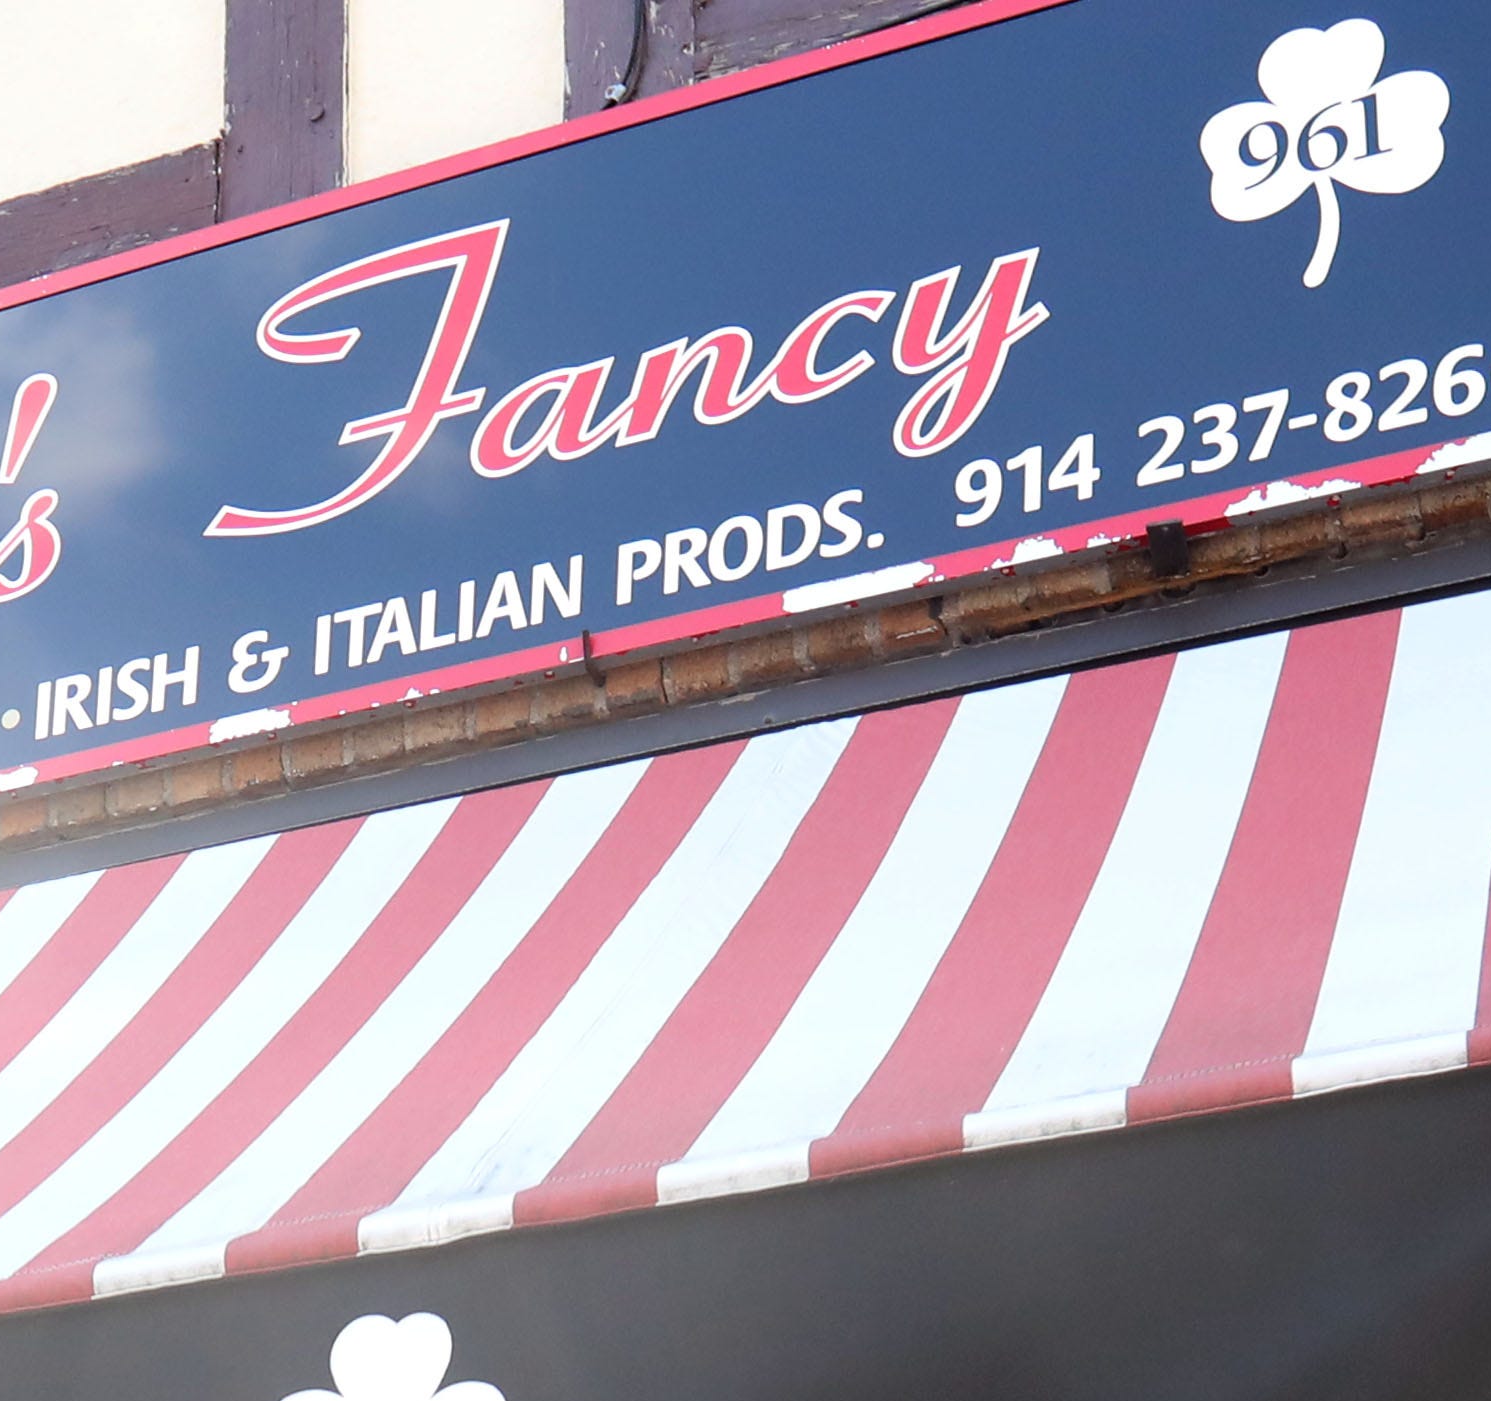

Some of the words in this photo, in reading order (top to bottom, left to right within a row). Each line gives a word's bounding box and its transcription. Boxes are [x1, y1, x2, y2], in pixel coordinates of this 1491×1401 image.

[1238, 94, 1394, 191] 961
[203, 215, 1050, 538] Fancy
[34, 645, 199, 743] IRISH
[229, 629, 287, 694] &
[315, 555, 585, 676] ITALIAN
[615, 488, 886, 607] PRODS.
[954, 434, 1100, 528] 914
